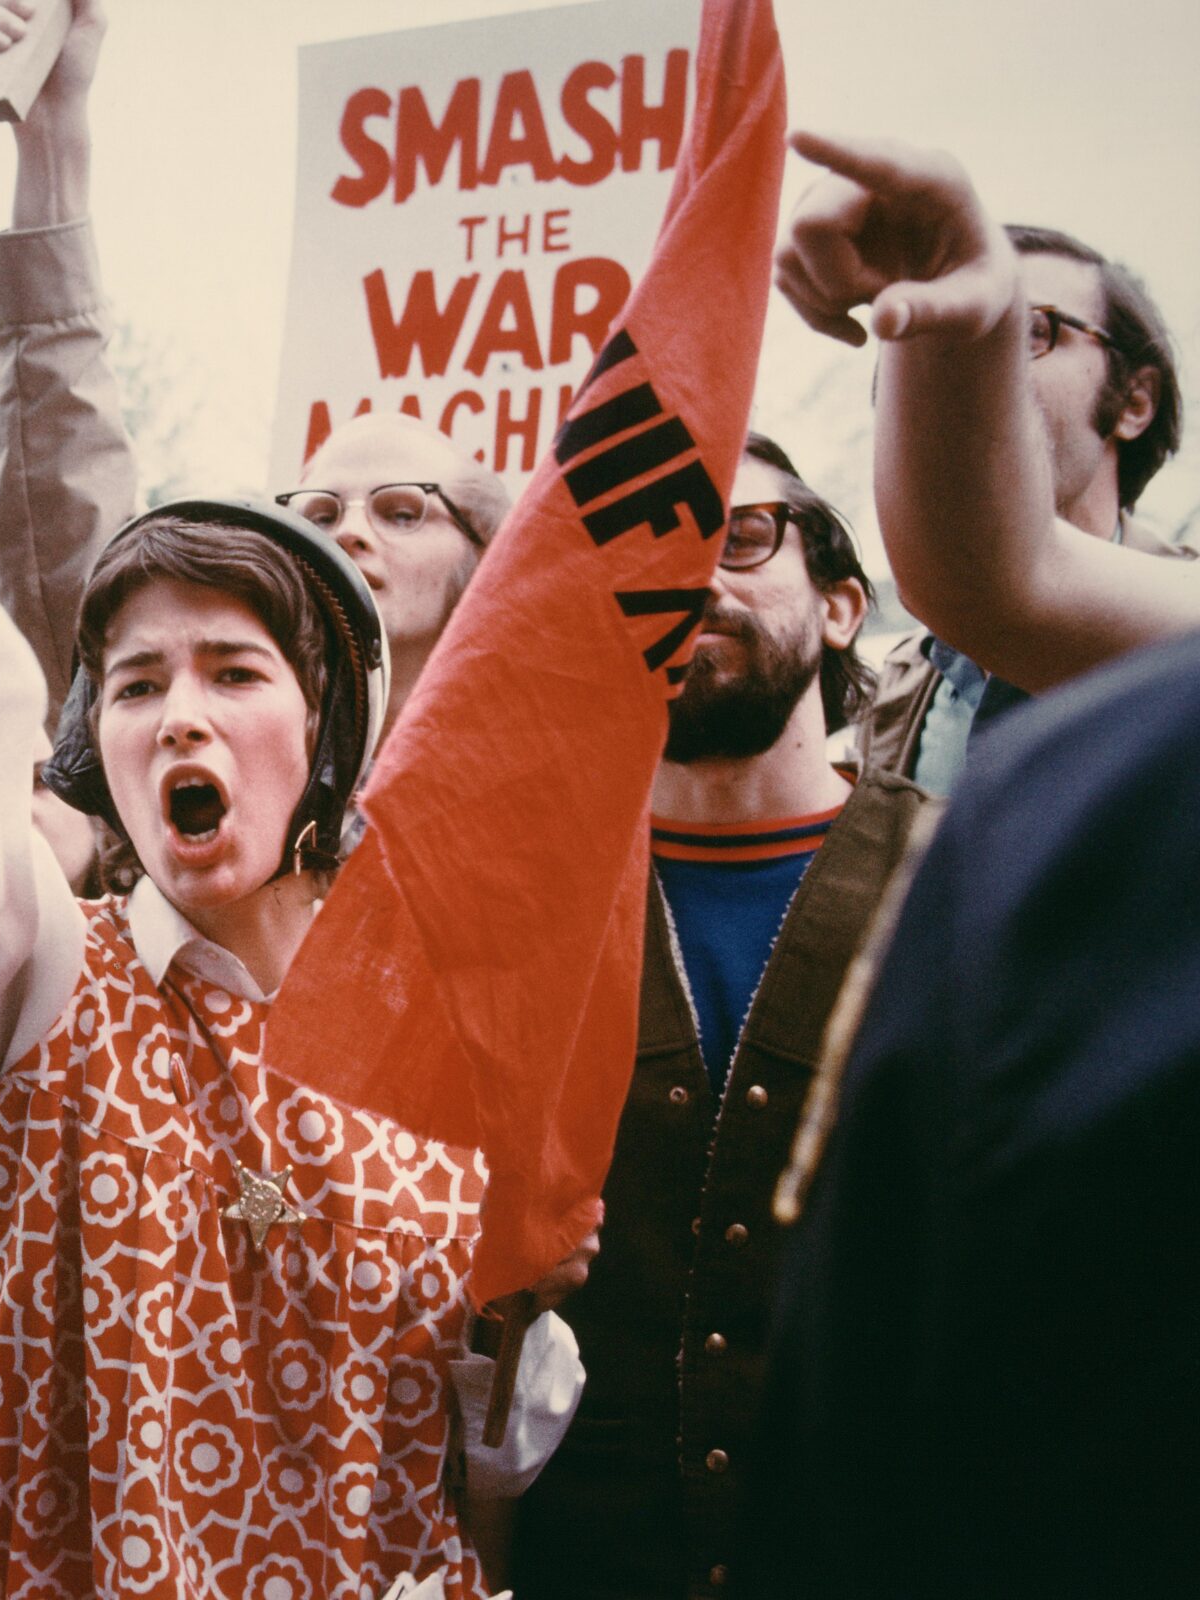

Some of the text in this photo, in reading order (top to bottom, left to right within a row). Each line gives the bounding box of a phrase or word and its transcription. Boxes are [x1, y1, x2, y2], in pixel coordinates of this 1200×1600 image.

[330, 47, 689, 208] SMASH
[458, 209, 571, 262] THE
[363, 256, 632, 380] WAR
